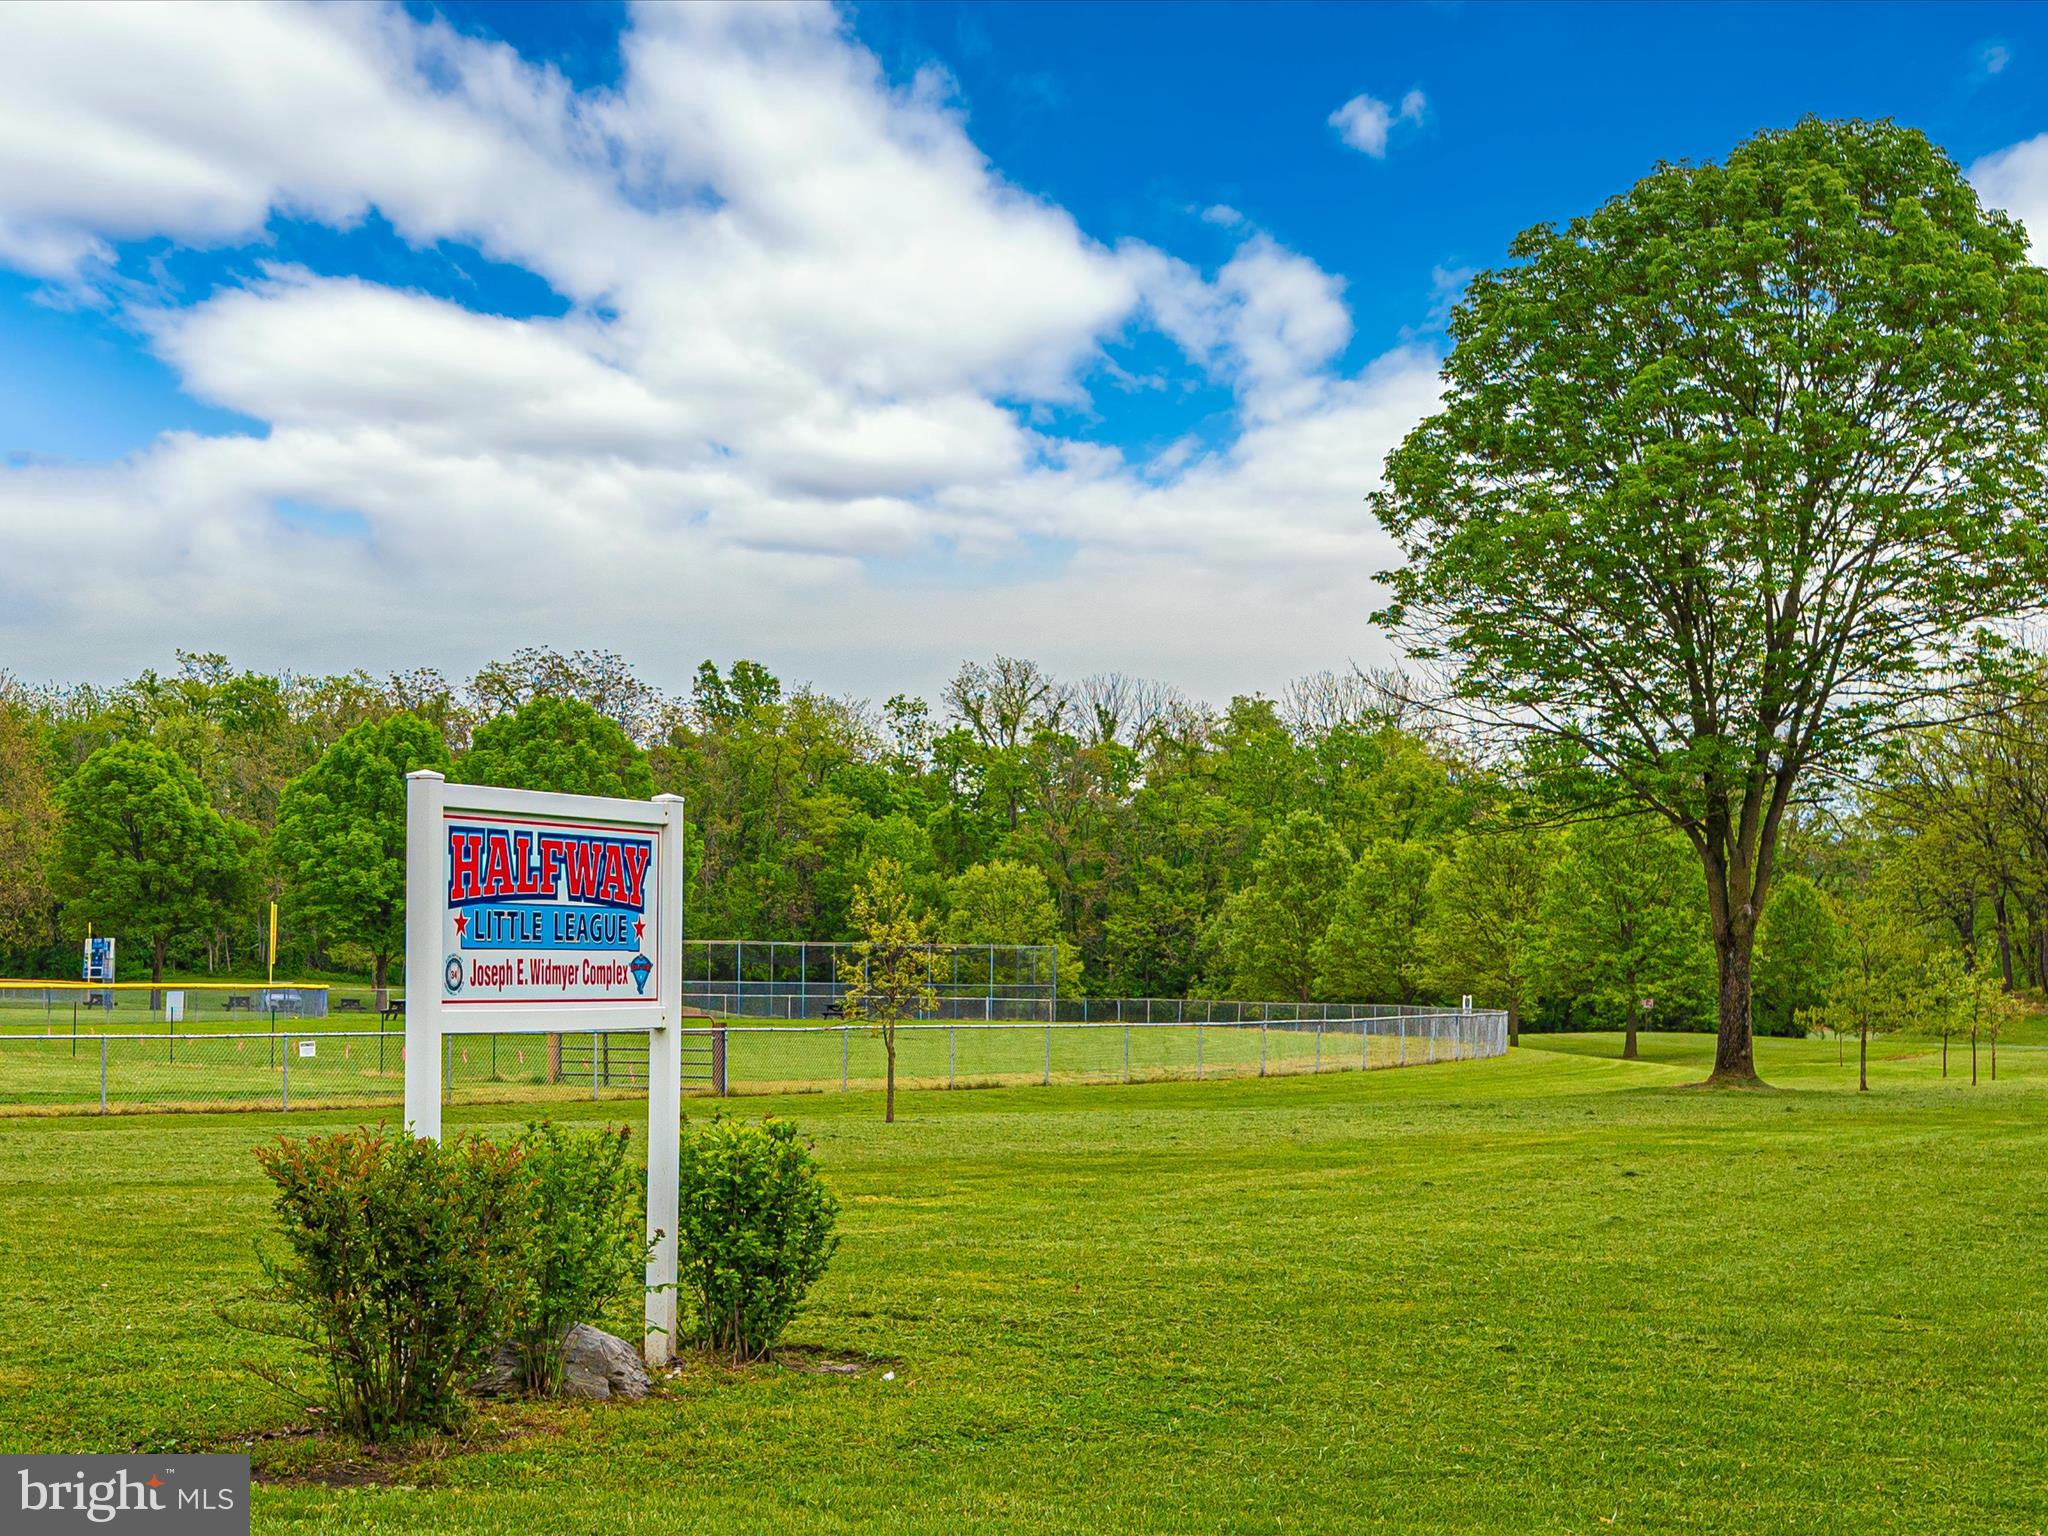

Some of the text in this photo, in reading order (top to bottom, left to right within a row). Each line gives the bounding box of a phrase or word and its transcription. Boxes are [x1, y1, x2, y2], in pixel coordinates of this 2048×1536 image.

[450, 832, 651, 908] HALFWAY
[473, 908, 628, 945] LITTLE LEAGUE
[469, 958, 513, 992] Joseph
[516, 958, 528, 985] E.
[529, 958, 580, 991] Widmyer
[582, 958, 629, 991] Complex
